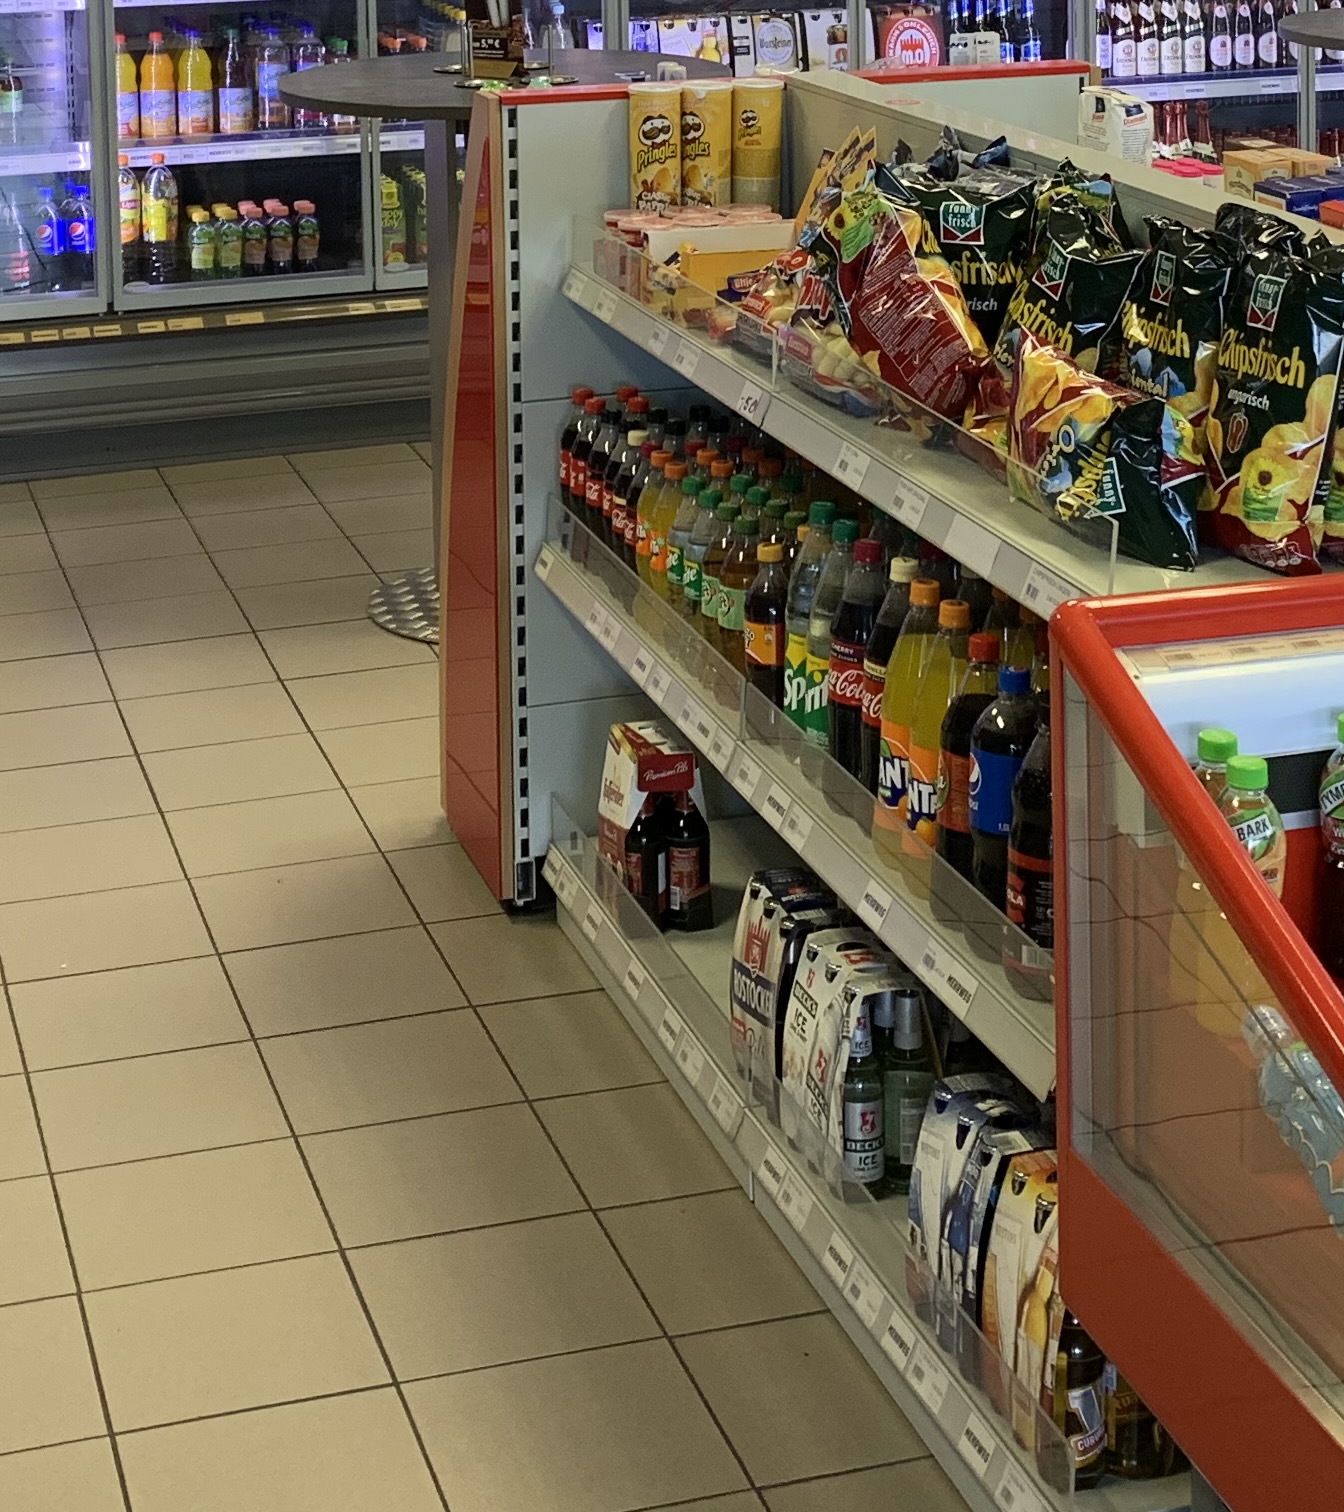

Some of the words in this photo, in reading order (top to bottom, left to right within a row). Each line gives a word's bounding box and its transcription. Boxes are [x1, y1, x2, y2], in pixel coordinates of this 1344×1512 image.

[636, 140, 678, 171] Pringles
[682, 139, 711, 161] ngles
[1217, 325, 1306, 389] Chipsfrisch
[880, 758, 910, 790] ANT
[1237, 817, 1271, 841] BARK
[858, 1154, 878, 1167] ICE
